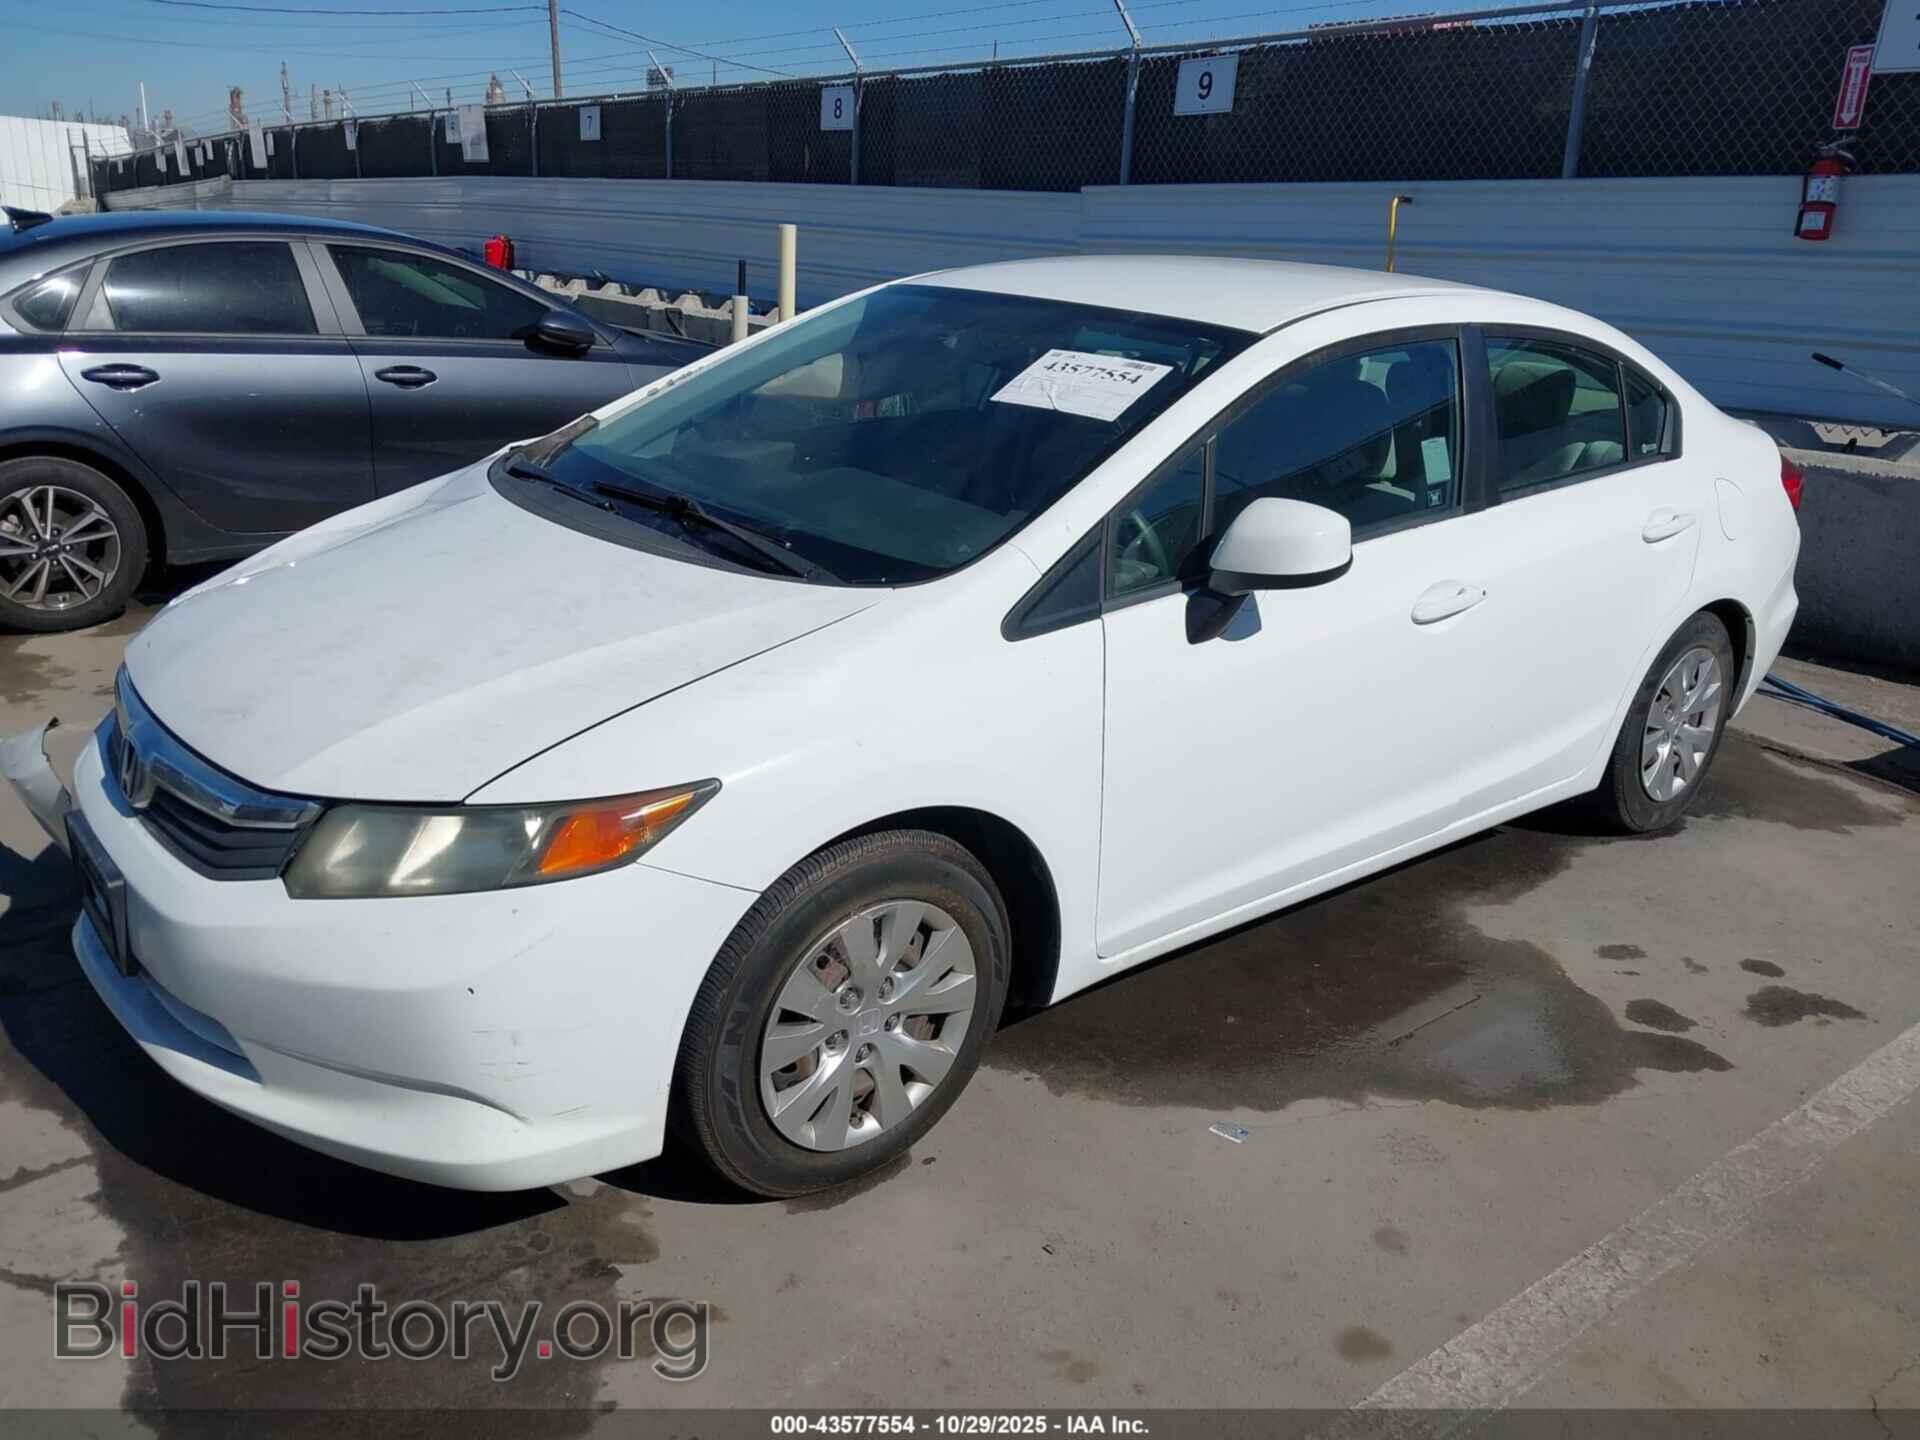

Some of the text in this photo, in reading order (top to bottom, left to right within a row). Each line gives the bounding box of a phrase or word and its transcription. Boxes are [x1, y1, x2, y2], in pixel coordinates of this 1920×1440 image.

[1197, 71, 1213, 101] 9
[833, 97, 843, 120] 8
[1043, 361, 1144, 385] 43577554
